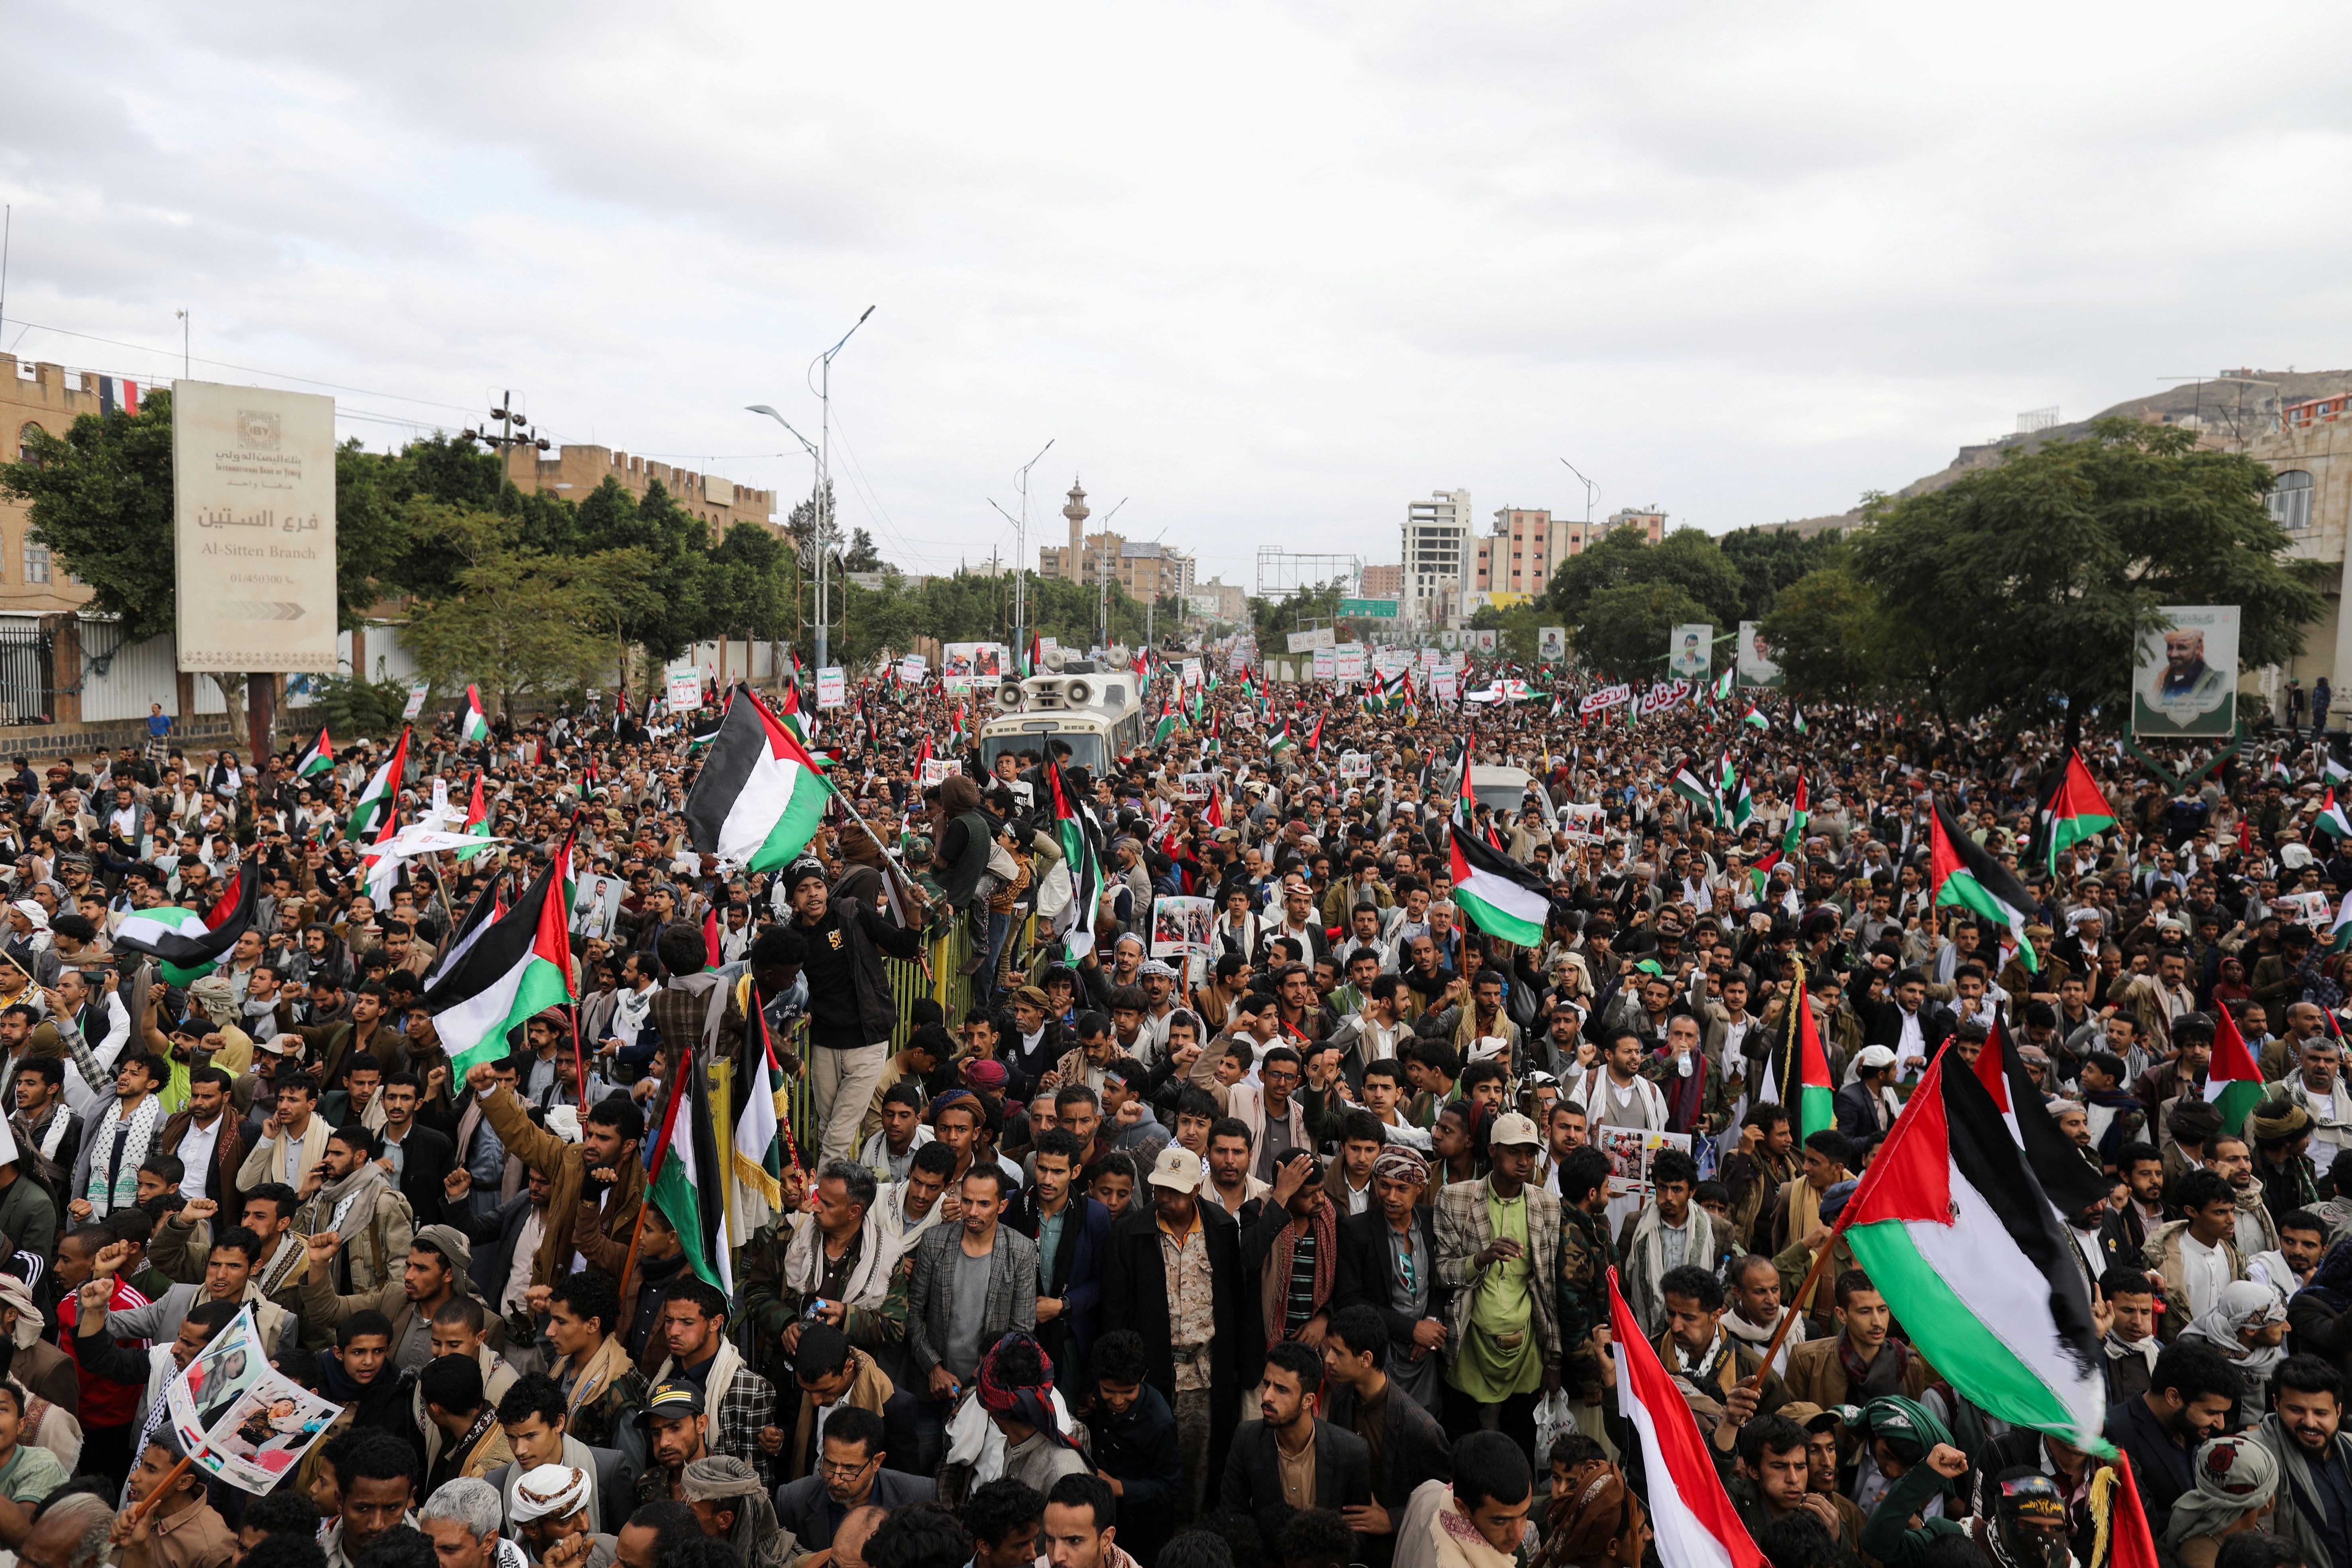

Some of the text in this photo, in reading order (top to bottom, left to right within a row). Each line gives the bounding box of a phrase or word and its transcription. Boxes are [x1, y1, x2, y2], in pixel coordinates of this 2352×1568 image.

[250, 426, 268, 436] IBY
[216, 451, 301, 467] بنك اليمن الدولي
[198, 507, 318, 533] فرع الستين
[201, 542, 316, 559] Al-Sitten Branch
[1645, 681, 1687, 710] طوفان
[1715, 1350, 1729, 1369] Nikon
